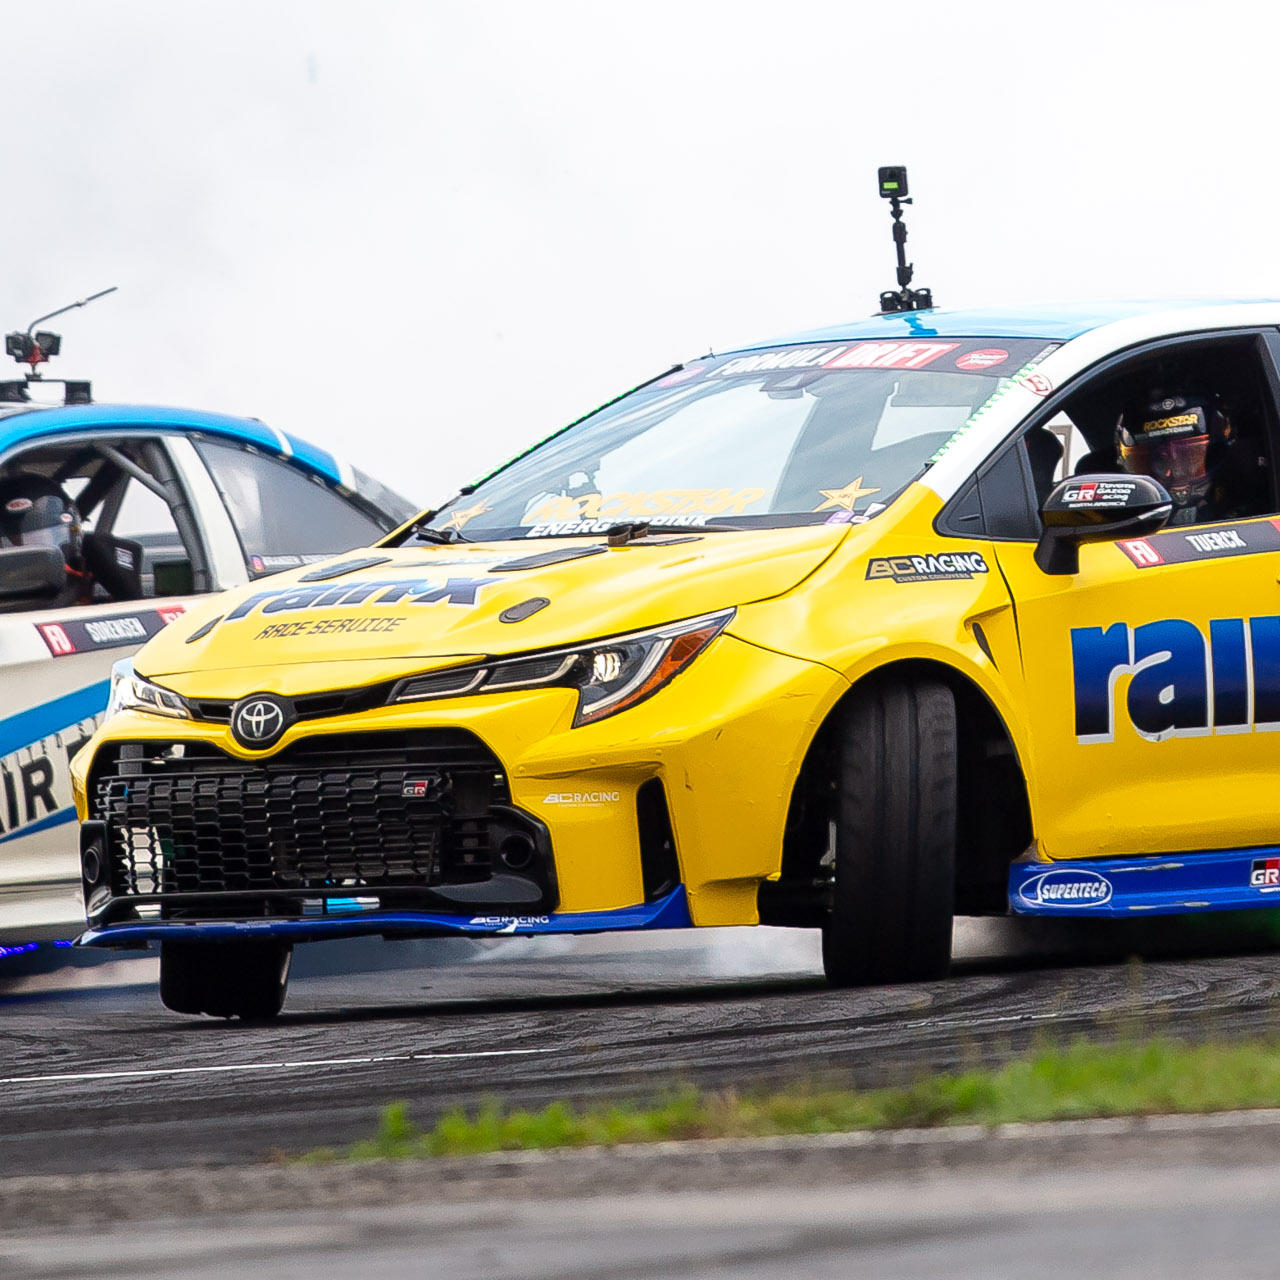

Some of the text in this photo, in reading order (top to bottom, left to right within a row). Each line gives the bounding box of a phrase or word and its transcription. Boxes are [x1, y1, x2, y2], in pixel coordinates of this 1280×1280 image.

[706, 346, 848, 377] FORMULA
[830, 342, 955, 368] DRIFT
[1143, 414, 1198, 432] ROCKSTAR
[1062, 489, 1094, 502] GR
[526, 516, 618, 537] ENERG
[1125, 540, 1159, 563] FD
[1185, 530, 1247, 552] TUERCK
[41, 624, 73, 651] FD
[84, 617, 147, 643] SORENSEN
[254, 617, 407, 641] RACE SERVICE
[1251, 869, 1279, 884] GR
